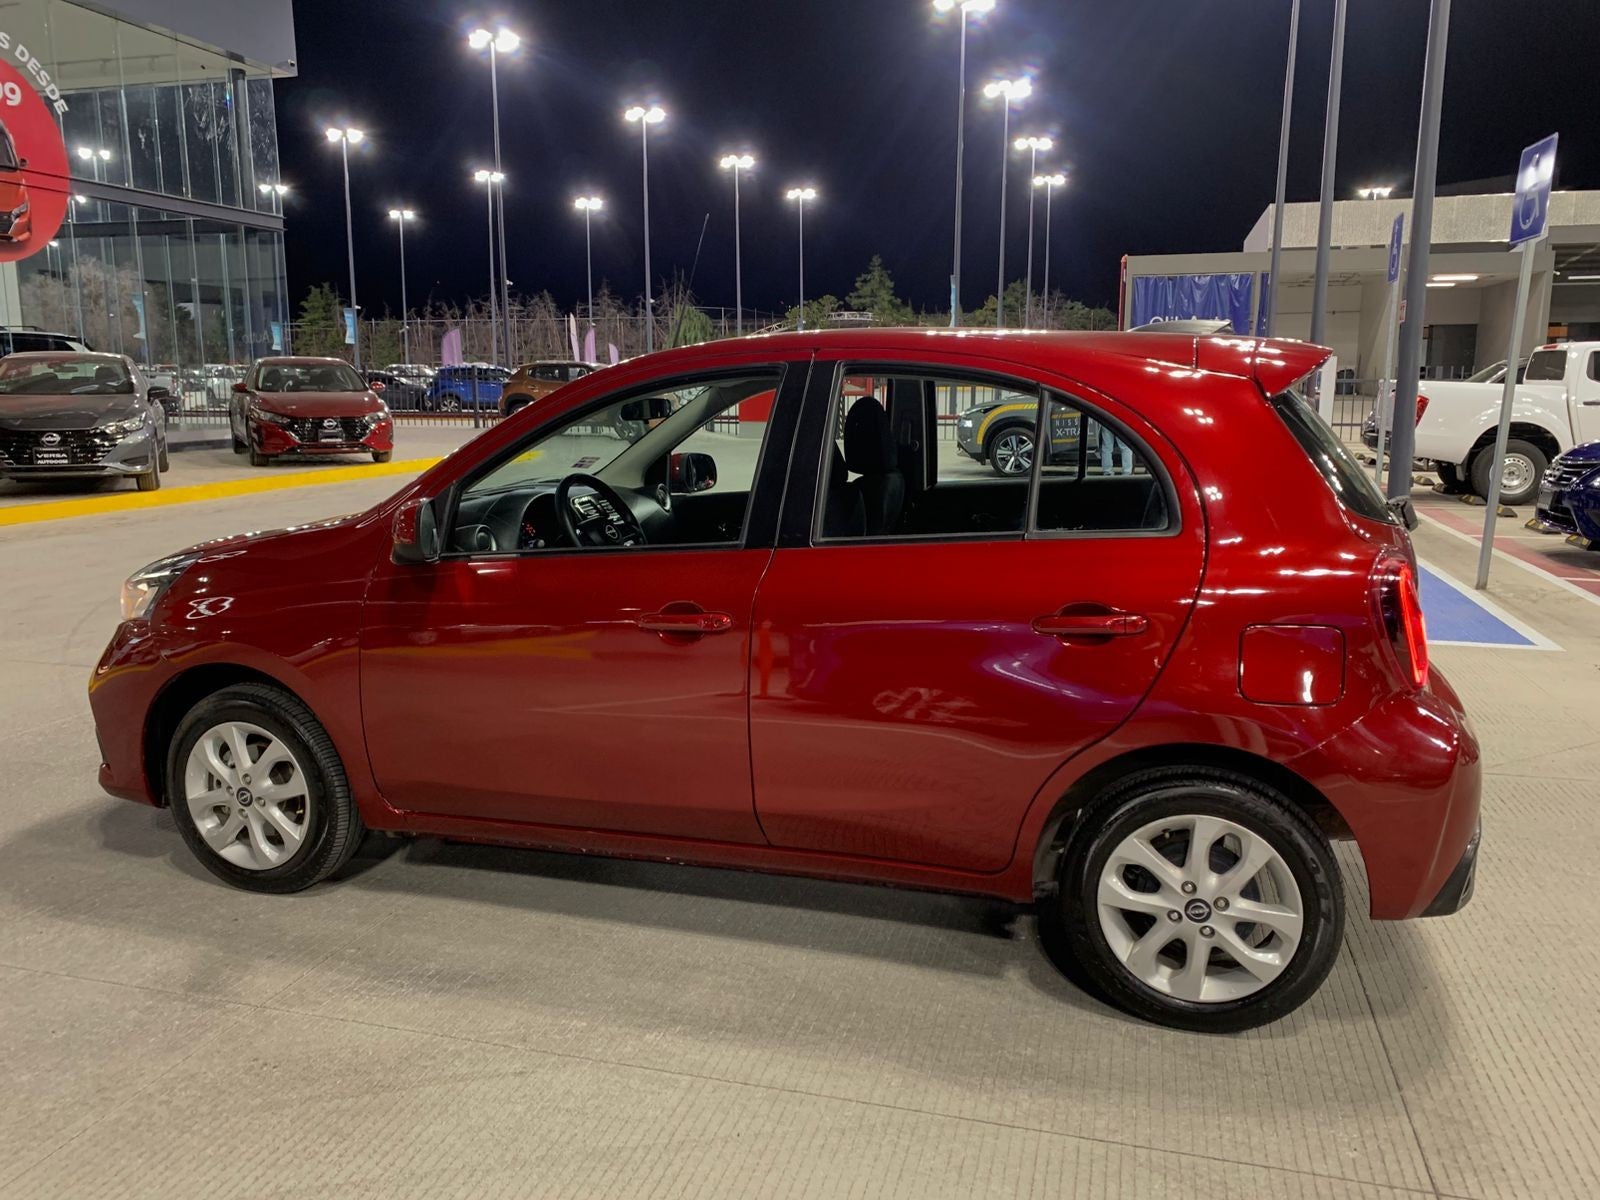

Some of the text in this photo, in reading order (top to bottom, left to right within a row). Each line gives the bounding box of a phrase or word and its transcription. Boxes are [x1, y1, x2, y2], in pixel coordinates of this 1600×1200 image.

[15, 44, 69, 115] DESDE
[0, 81, 21, 106] 9
[1055, 416, 1094, 427] NISSN
[1056, 426, 1094, 437] X-TRL
